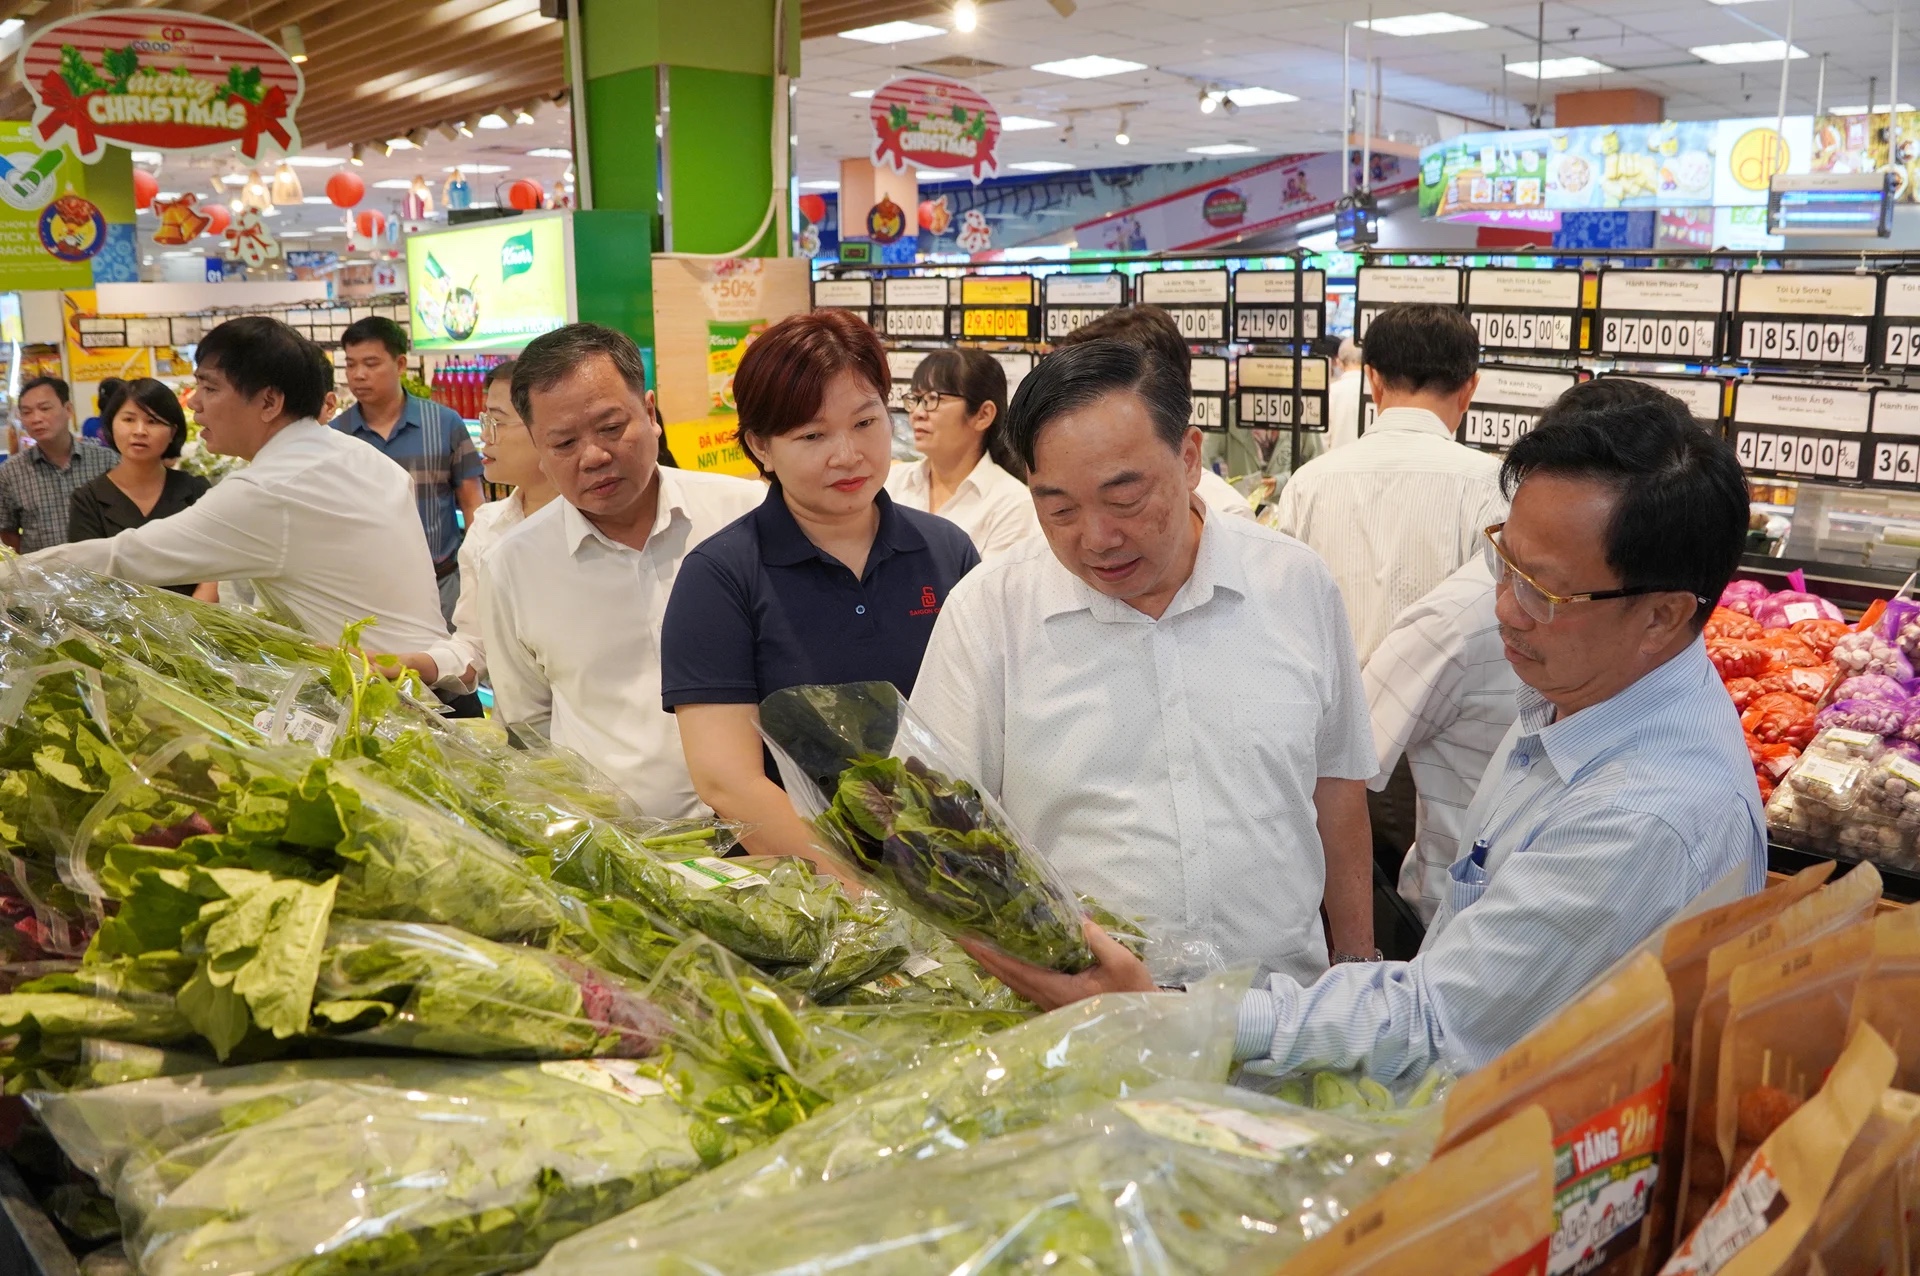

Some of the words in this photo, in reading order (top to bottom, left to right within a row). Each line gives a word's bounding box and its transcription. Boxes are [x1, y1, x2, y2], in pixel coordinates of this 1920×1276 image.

[88, 95, 248, 130] CHRISTMAS
[899, 131, 978, 158] CHRISTMAS
[502, 246, 533, 265] Knorr
[711, 279, 756, 297] +50%
[1802, 286, 1820, 294] Sơn
[1822, 288, 1832, 296] kg
[889, 314, 932, 330] 65.000
[967, 314, 1013, 330] 29.900
[1050, 314, 1100, 331] 39.90
[1241, 314, 1289, 332] 21.90
[708, 335, 738, 346] Knorr
[1606, 322, 1690, 346] 87.000
[1749, 327, 1840, 354] 185.00
[1771, 394, 1793, 402] Hành
[1794, 396, 1807, 404] tím
[1880, 402, 1903, 410] Hành
[697, 450, 718, 469] NAY
[1740, 438, 1834, 467] 47.900
[909, 608, 933, 616] SAIGON
